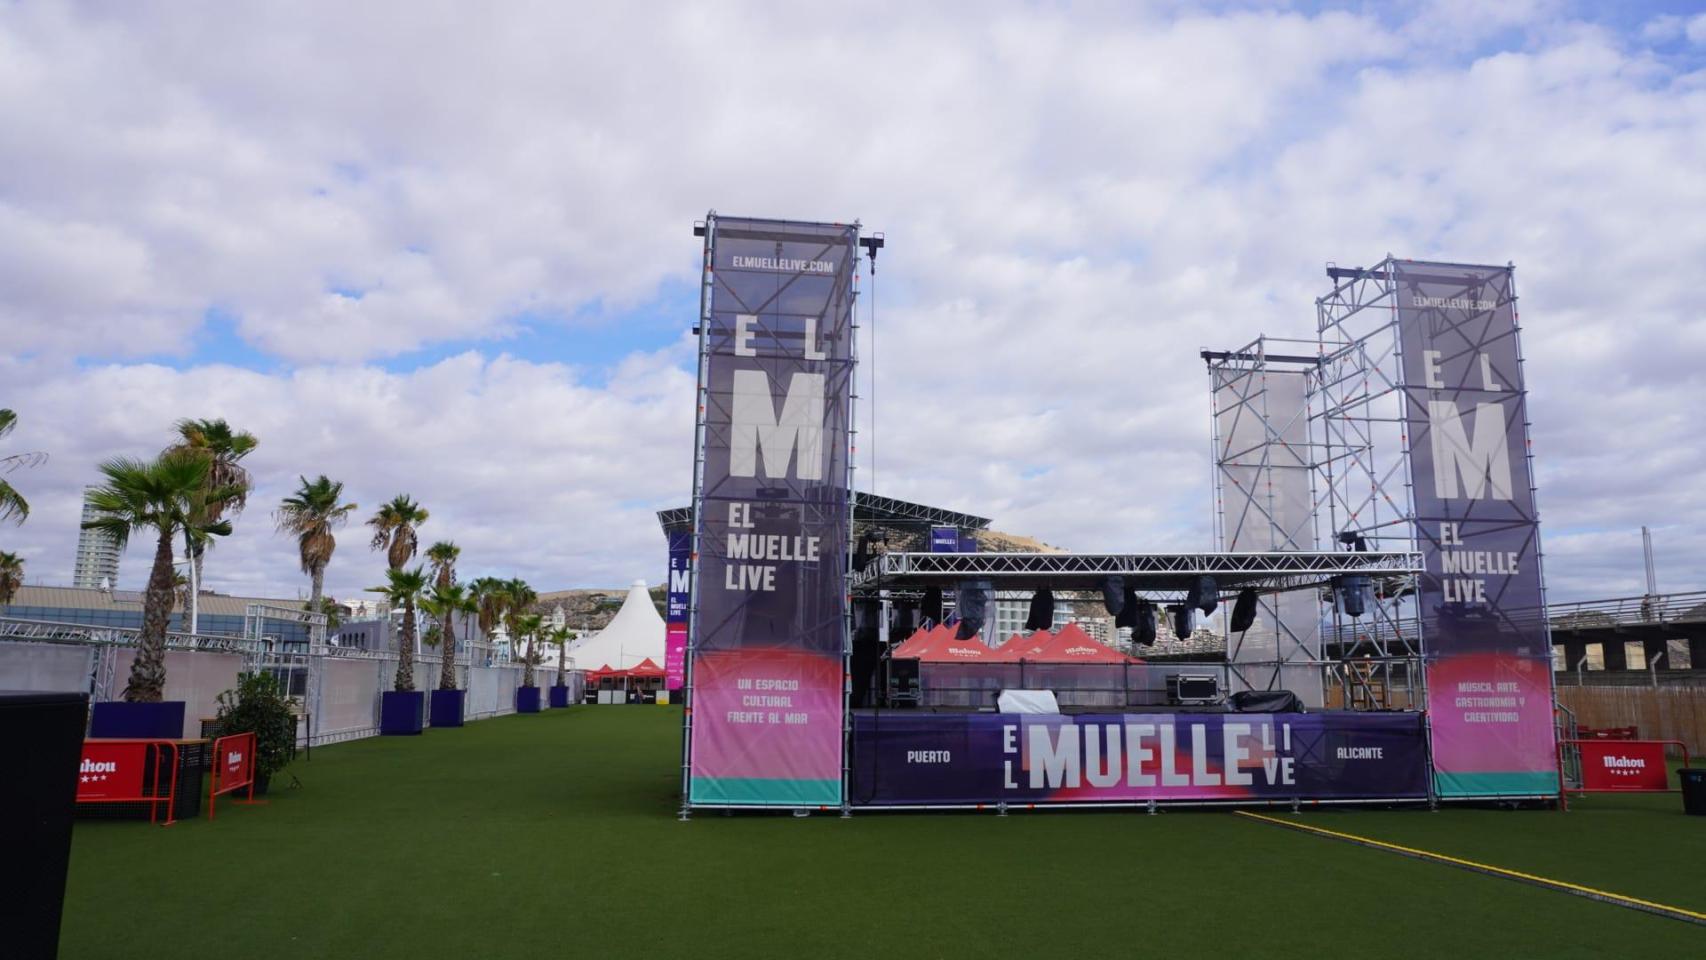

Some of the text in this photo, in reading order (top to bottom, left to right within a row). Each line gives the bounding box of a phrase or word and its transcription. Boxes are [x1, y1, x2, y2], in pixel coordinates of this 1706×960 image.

[732, 255, 834, 273] ELMUELLELIVE.COM
[1413, 296, 1497, 311] ELMUELLELIVE.COM
[729, 369, 825, 480] M
[1428, 400, 1513, 500] M
[728, 503, 755, 528] EL
[1439, 521, 1464, 545] EL
[726, 533, 820, 562] MUELLE
[1441, 550, 1520, 575] MUELLE
[725, 564, 777, 591] LIVE
[1442, 578, 1487, 603] LIVE
[737, 679, 799, 691] UN ESPACIO
[742, 695, 793, 708] CULTURAL
[1519, 696, 1526, 708] Y
[727, 711, 808, 725] FRENTE AL MAR
[907, 750, 951, 764] PUERTO
[1028, 723, 1253, 789] MUELLE
[1337, 747, 1384, 760] ALICANTE
[1603, 755, 1645, 768] Mahou
